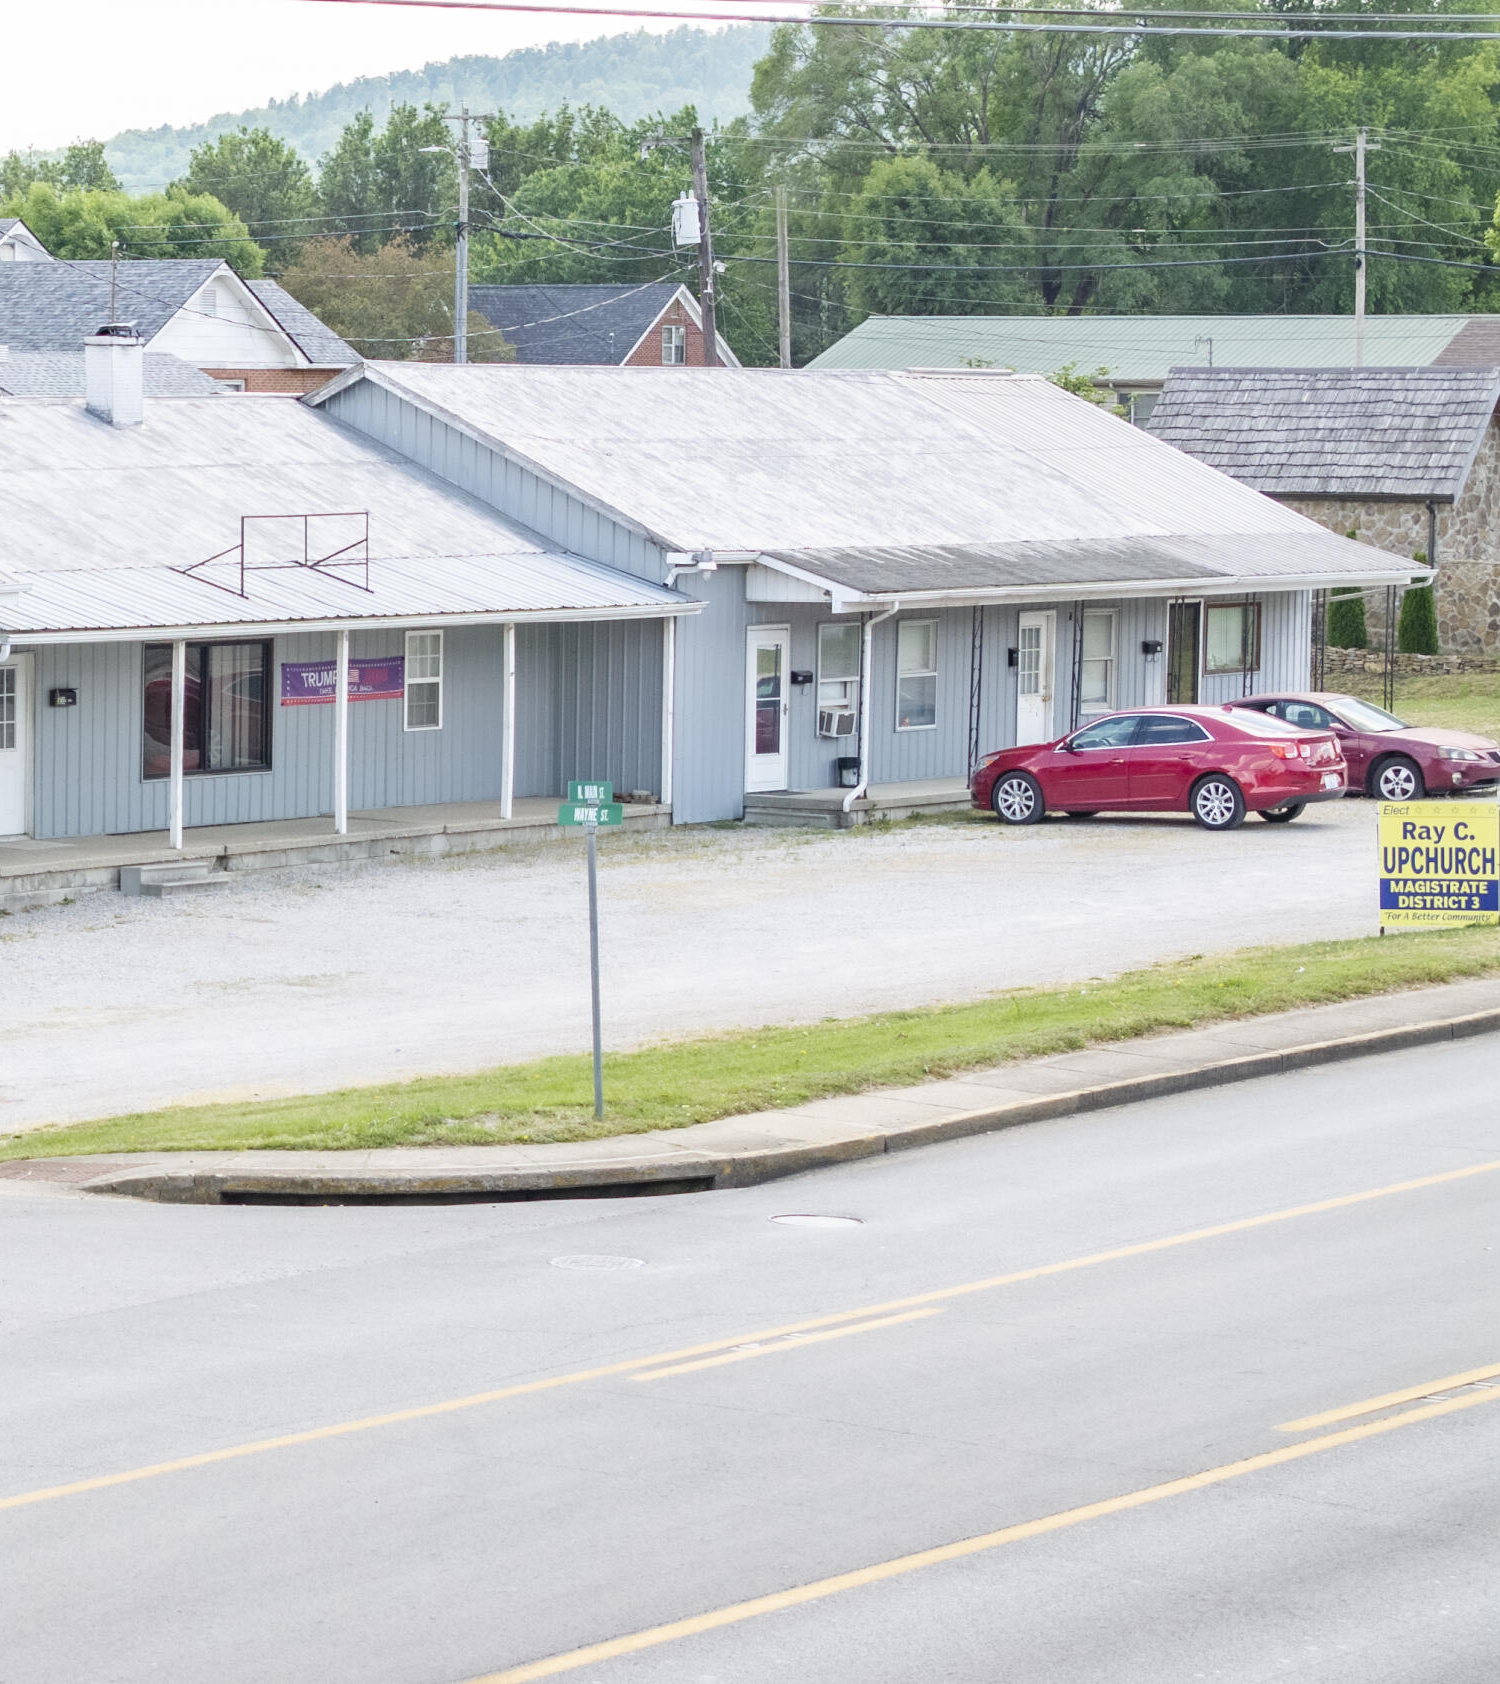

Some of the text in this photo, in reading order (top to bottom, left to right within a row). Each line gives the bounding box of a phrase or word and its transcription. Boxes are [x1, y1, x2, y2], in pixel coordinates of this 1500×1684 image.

[301, 670, 338, 688] TRUMP
[573, 807, 598, 822] WAYNE
[1383, 804, 1409, 815] Elect
[1402, 821, 1476, 844] Ray C.
[1383, 846, 1495, 875] UPCHURCH
[1390, 880, 1489, 895] MAGISTRATE
[1398, 895, 1480, 909] DISTRICT 3
[1403, 912, 1409, 920] A
[1412, 912, 1440, 921] Better
